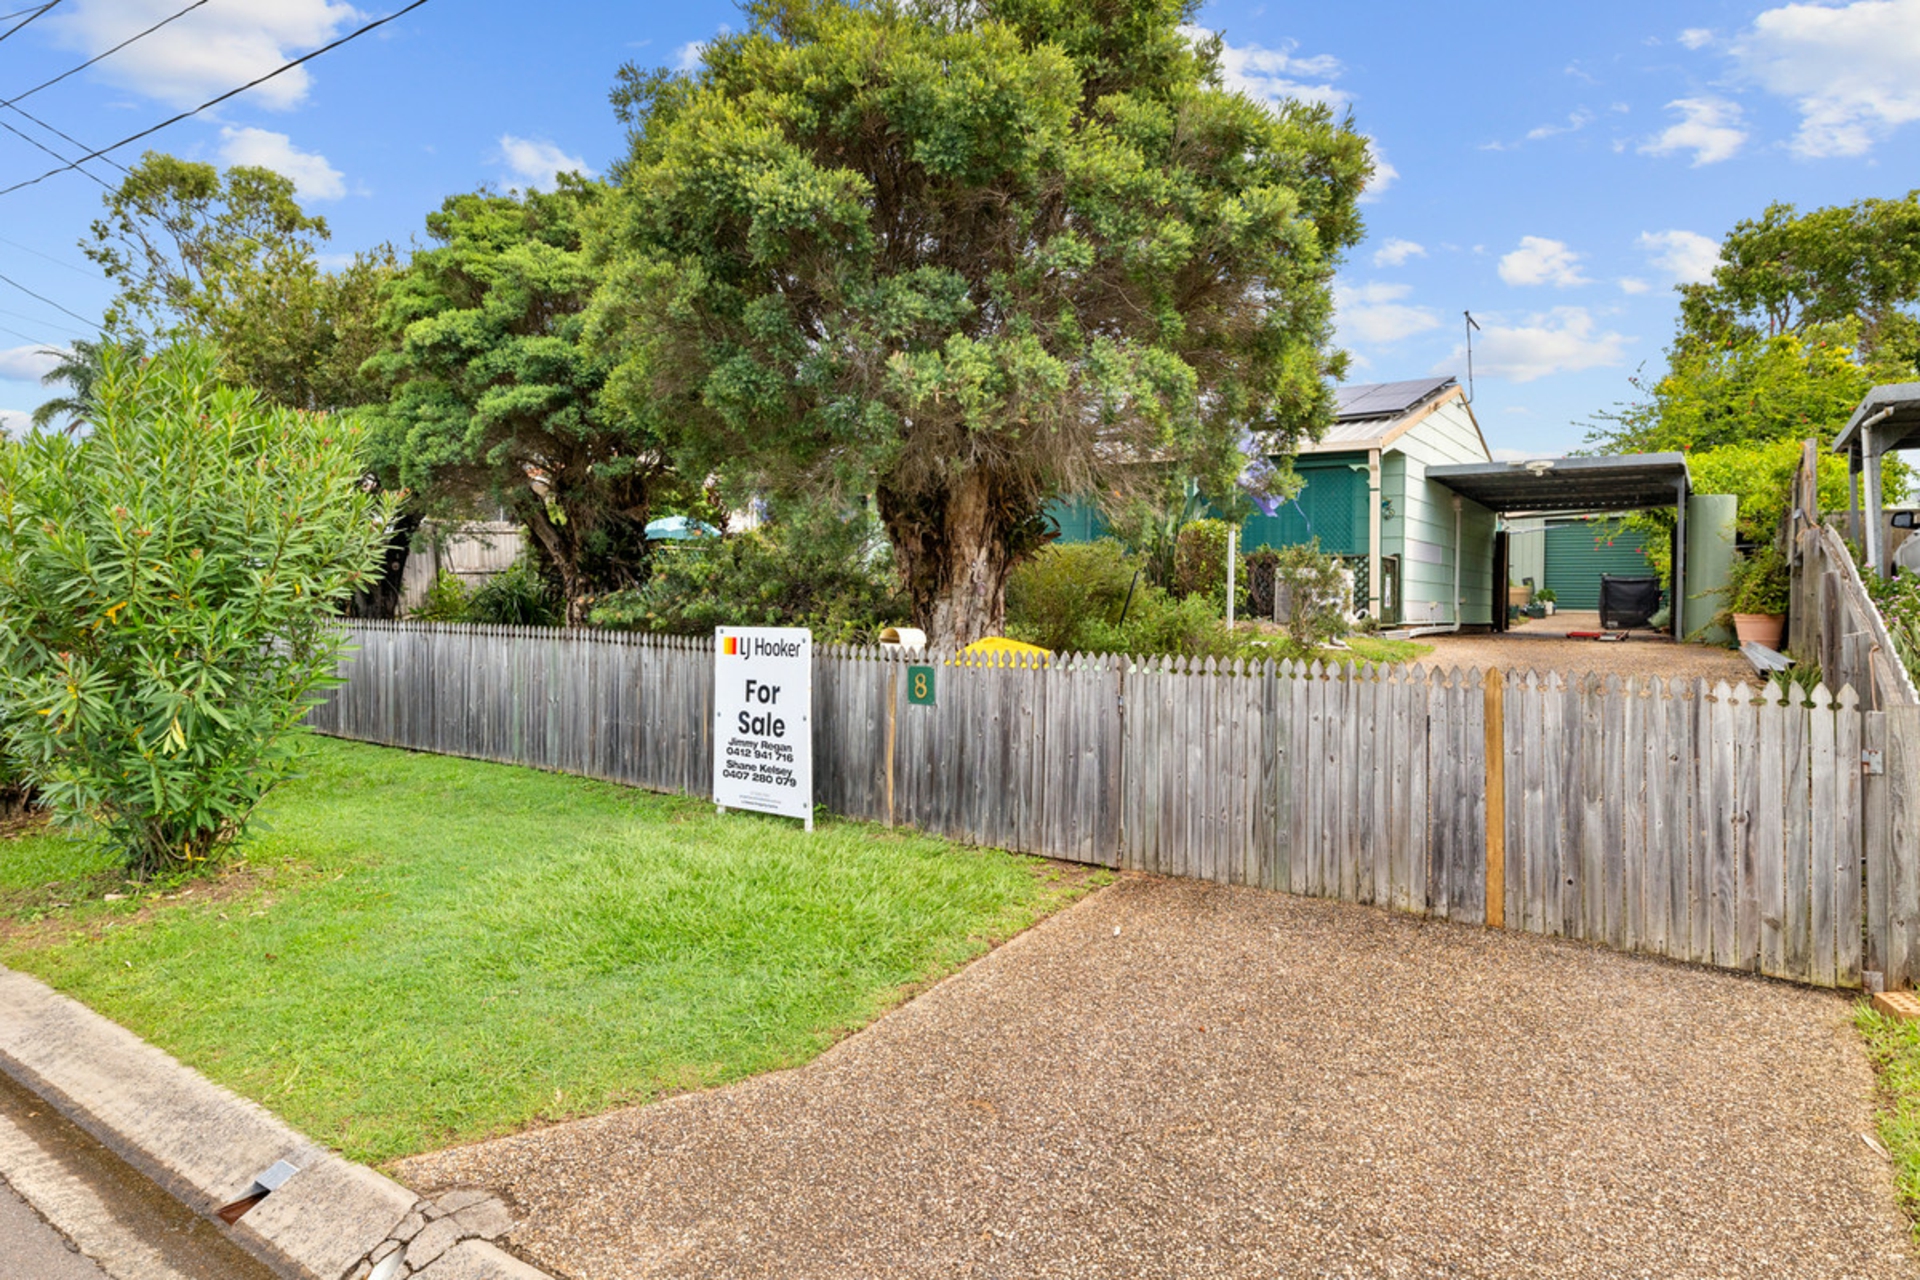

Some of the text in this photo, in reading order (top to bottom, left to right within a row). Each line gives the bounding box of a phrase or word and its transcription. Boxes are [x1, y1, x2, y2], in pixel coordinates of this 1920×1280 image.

[740, 637, 801, 660] LJ Hooker
[745, 679, 781, 704] For
[915, 673, 927, 698] 8
[738, 710, 785, 737] Sale
[726, 747, 794, 763] 0412 941 716
[728, 737, 793, 754] Jimmy Regan
[723, 769, 797, 787] 0407 280 079
[726, 759, 793, 778] Shane Kelsey
